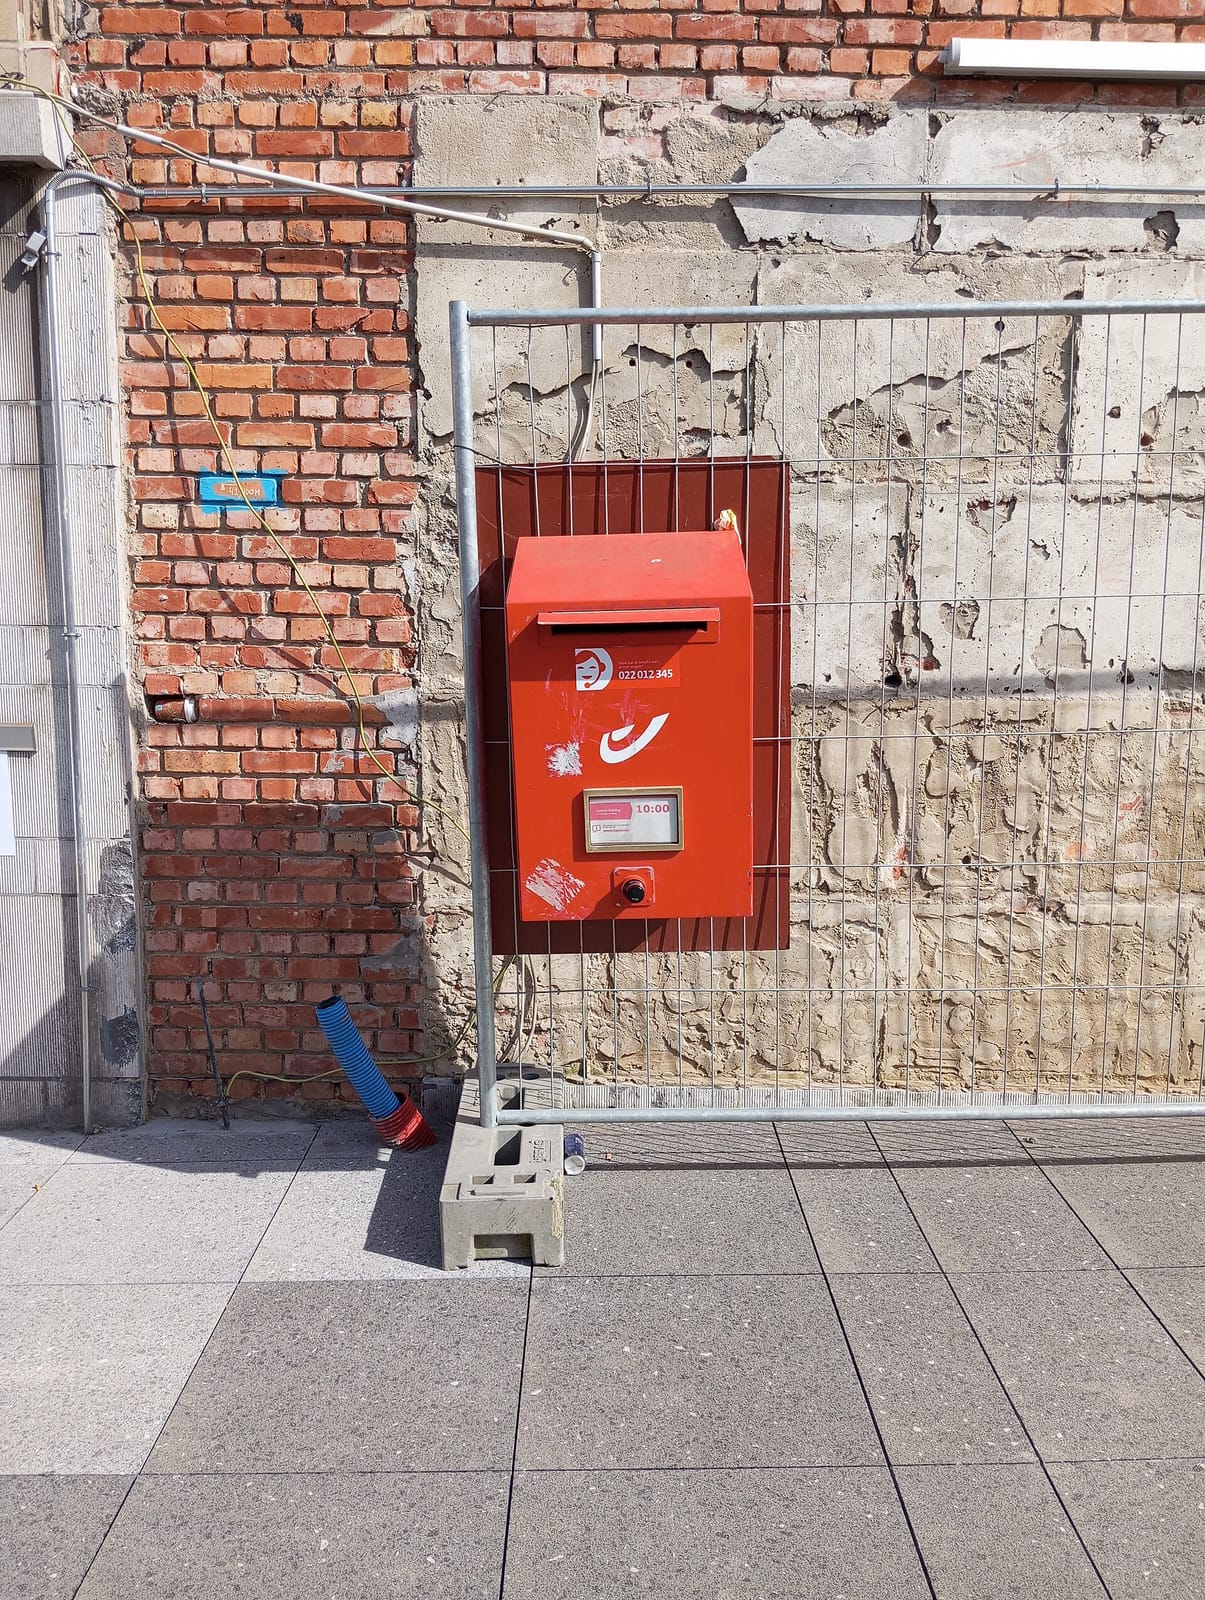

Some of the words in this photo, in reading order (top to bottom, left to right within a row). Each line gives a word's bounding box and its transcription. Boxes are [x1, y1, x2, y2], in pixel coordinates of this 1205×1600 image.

[618, 670, 636, 680] 022
[637, 670, 655, 679] 012
[655, 669, 673, 679] 345
[637, 804, 670, 814] 10:00
